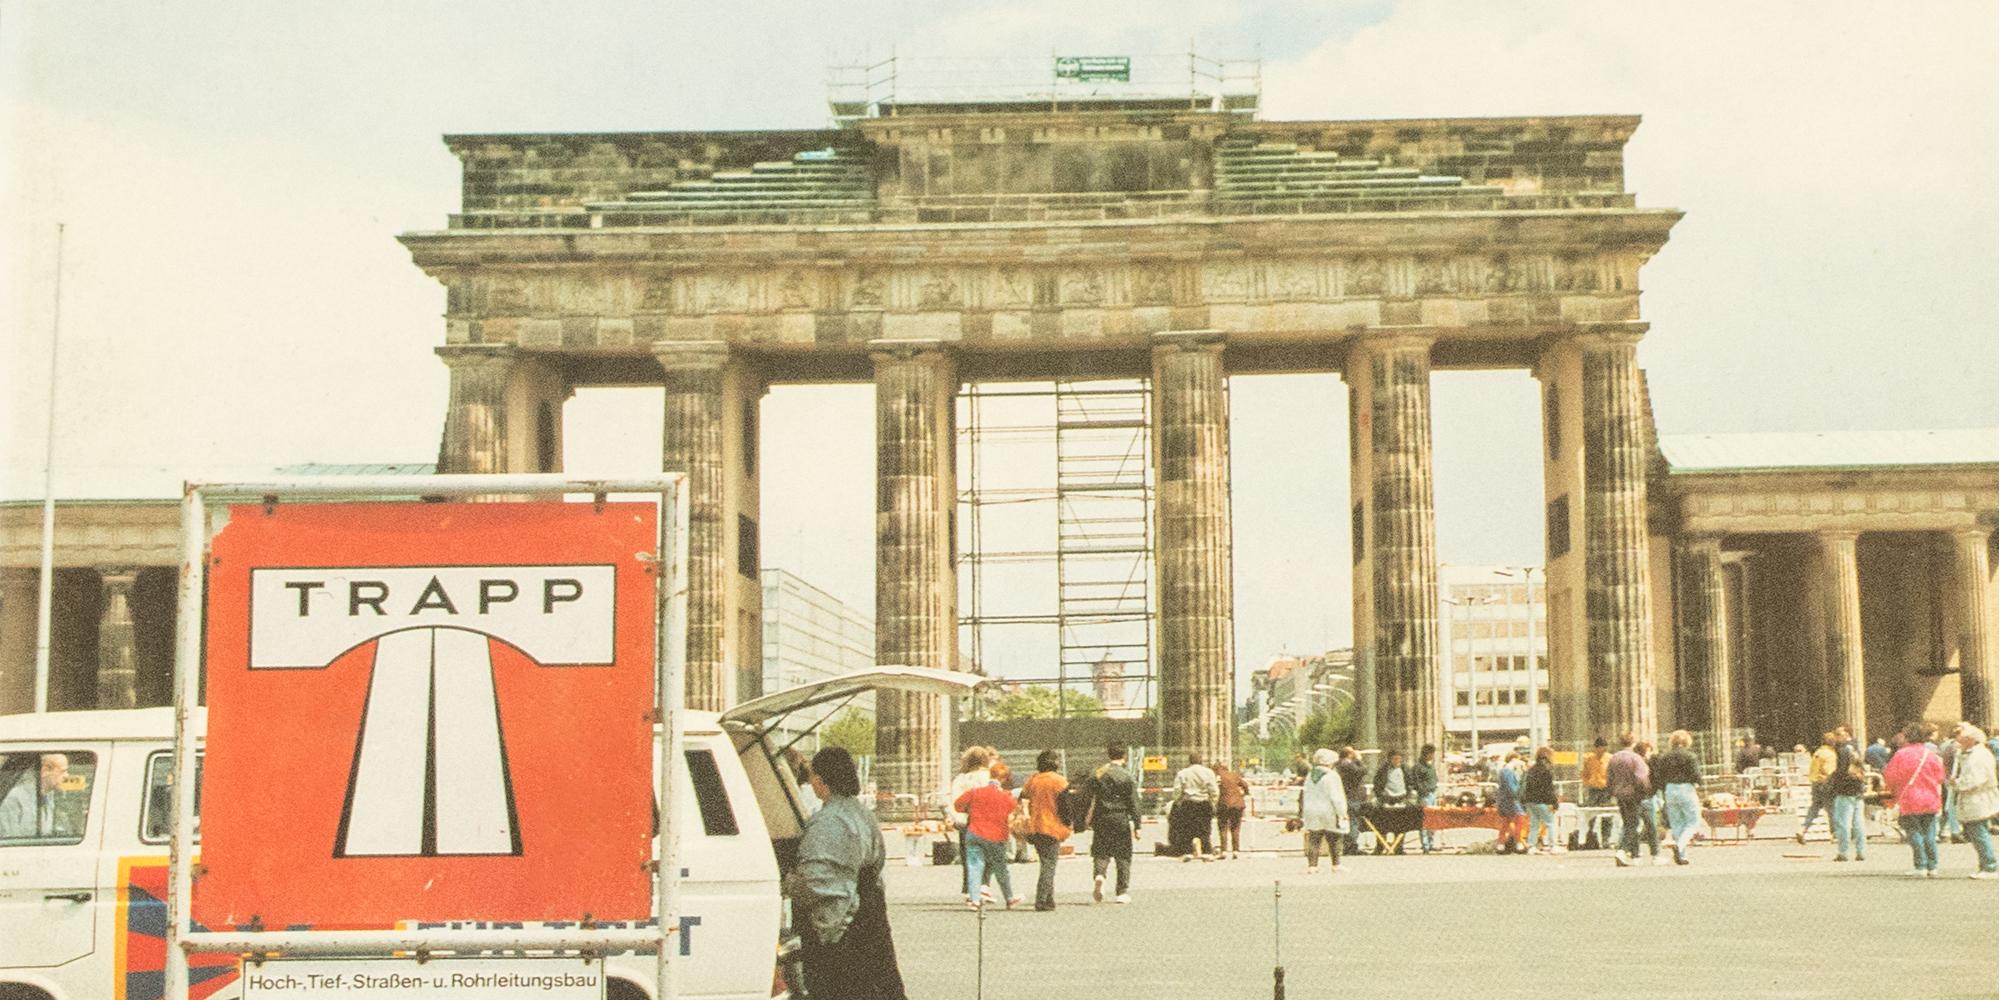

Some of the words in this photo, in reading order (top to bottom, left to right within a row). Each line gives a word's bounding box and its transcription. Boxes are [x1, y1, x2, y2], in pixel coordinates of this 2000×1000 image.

[285, 574, 584, 617] TRAPP
[433, 978, 448, 988] u.
[451, 973, 597, 990] Rohrleitungsbau
